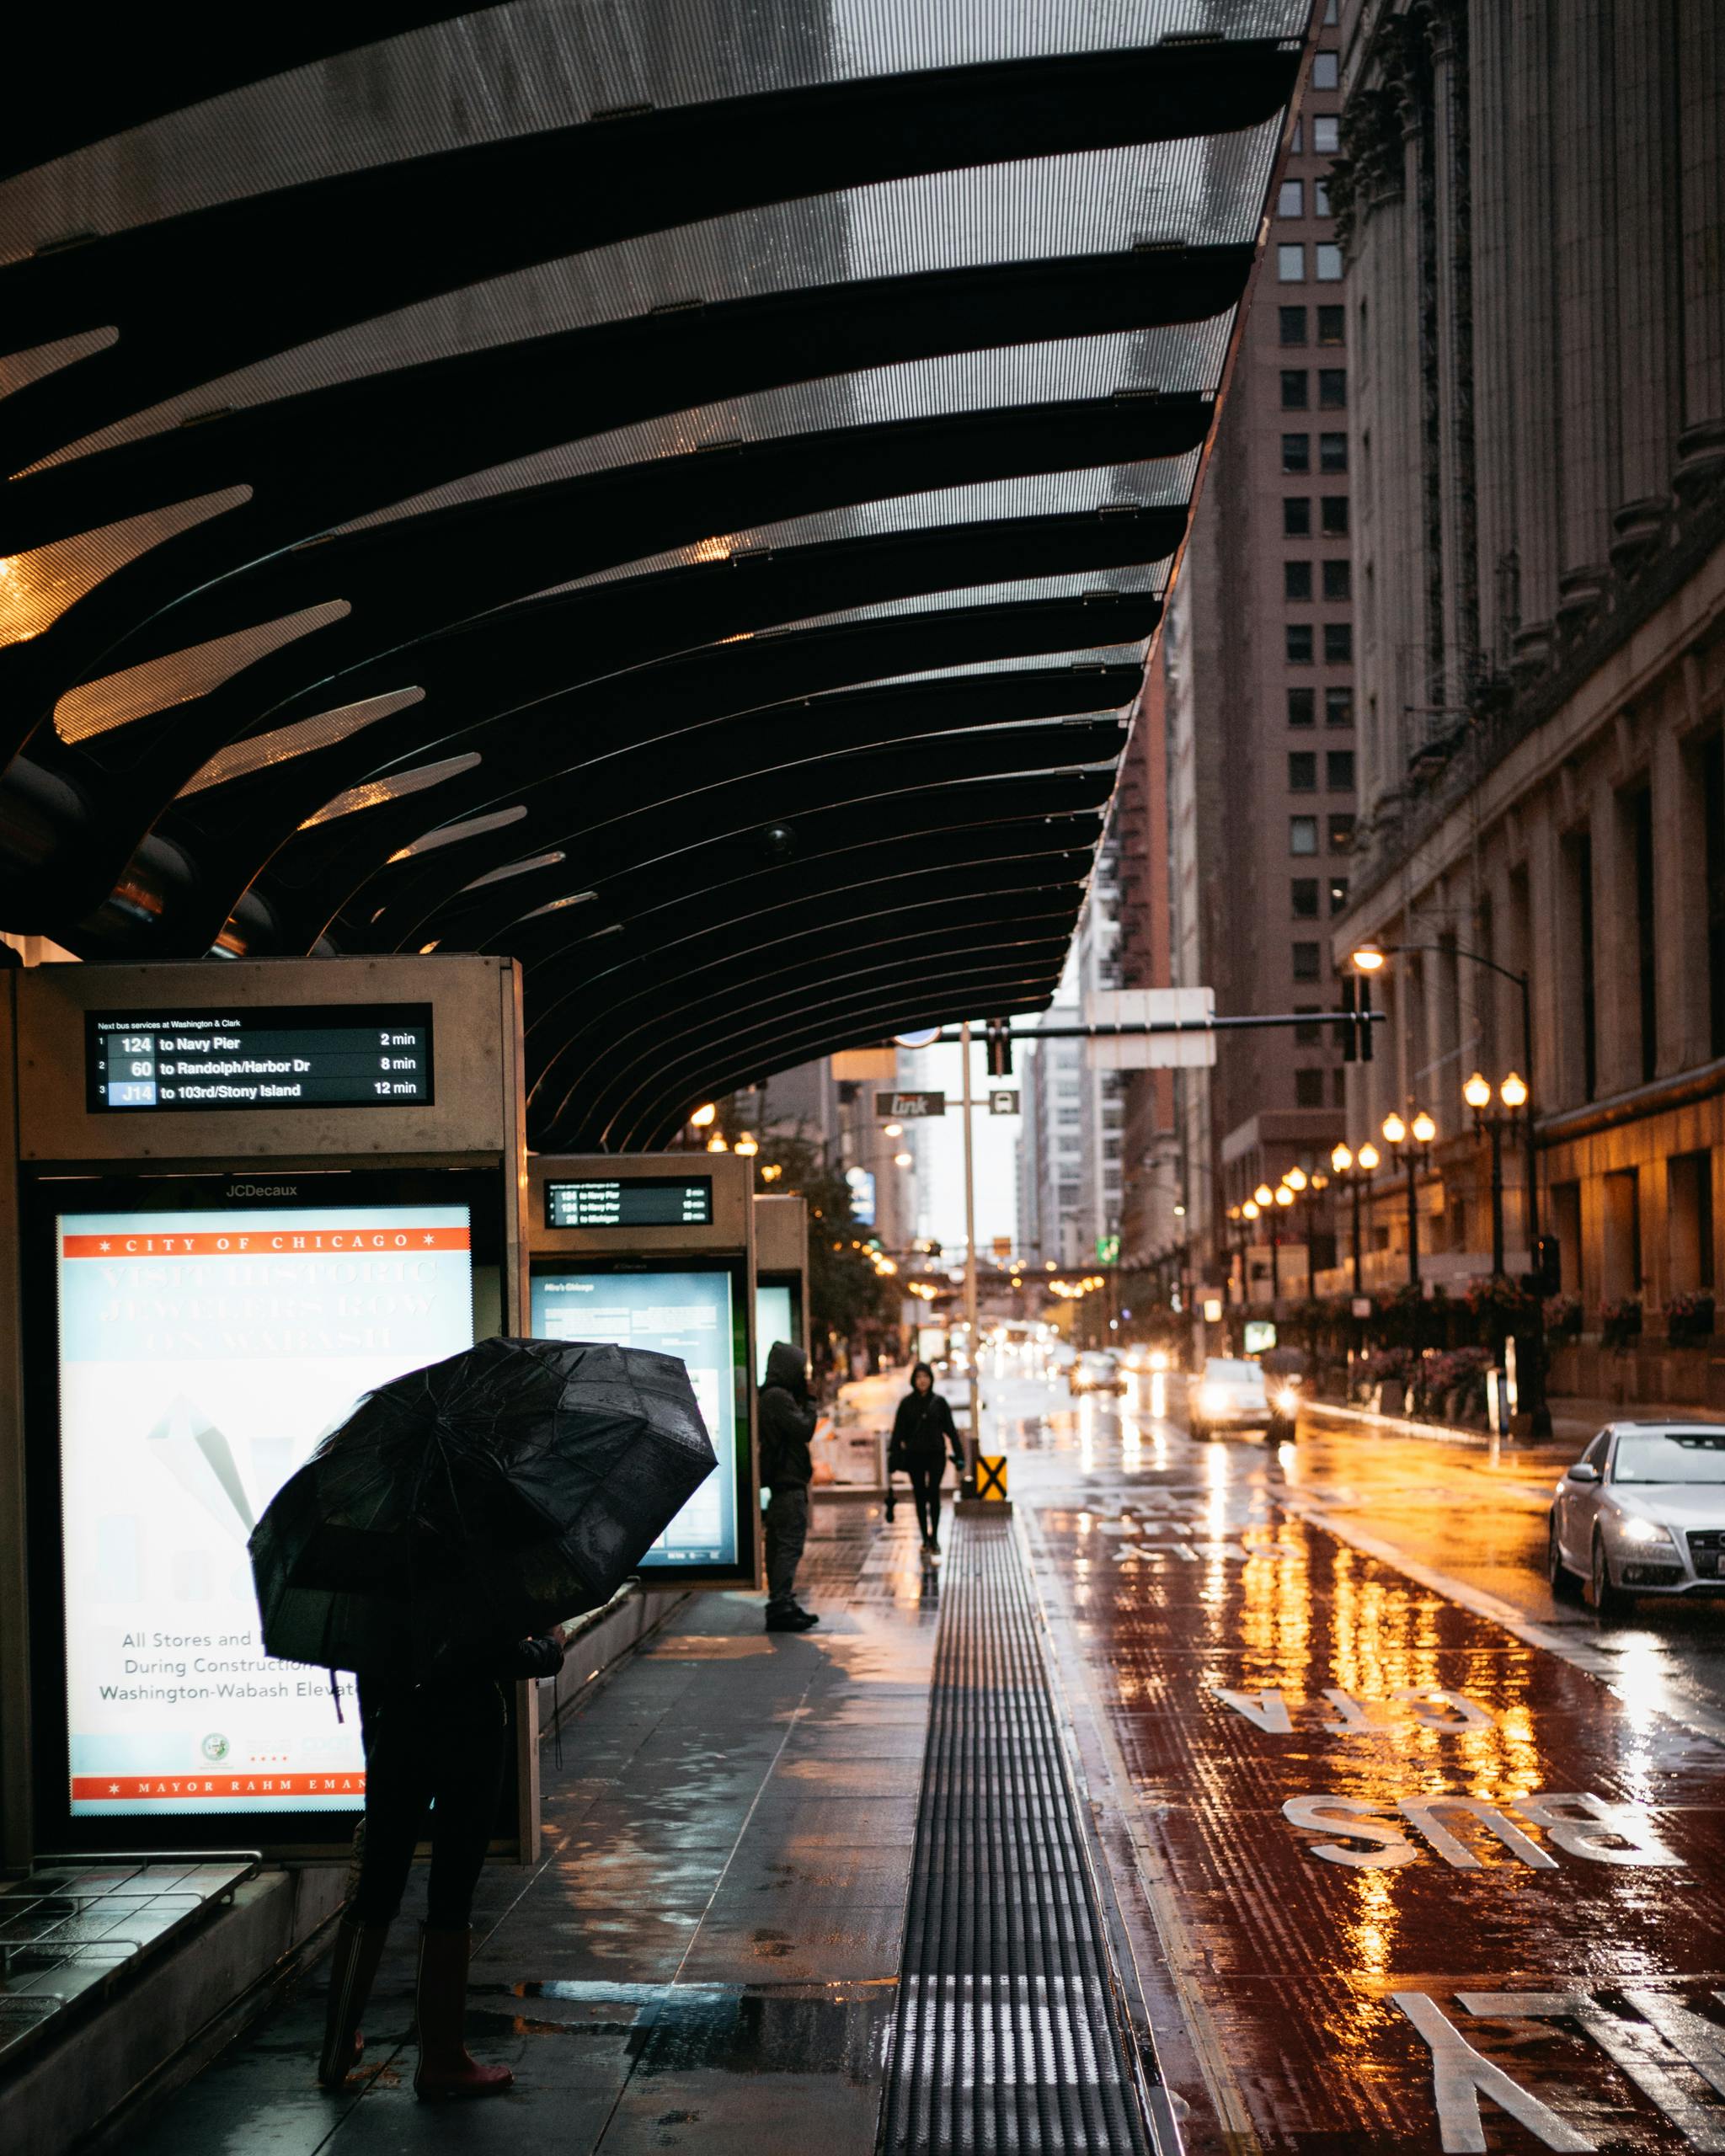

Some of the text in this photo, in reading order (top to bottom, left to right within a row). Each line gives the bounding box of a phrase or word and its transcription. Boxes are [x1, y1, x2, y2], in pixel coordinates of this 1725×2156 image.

[98, 1019, 241, 1031] Next bus services at Washington & Clark
[99, 1033, 416, 1053] 1 124 to Navy Pier 2 min
[99, 1057, 416, 1077] 2 60 to Randolph/Harbor Dr 8 min
[99, 1081, 417, 1101] 3 J14 to 103rd/Stony Island 12 min
[226, 1184, 297, 1198] JCDecaux
[126, 1234, 409, 1252] CITY OF CHICAGO
[100, 1259, 439, 1289] VISIT HISTORIC
[99, 1293, 437, 1322] JEWELERS ROW
[222, 1326, 392, 1351] WABASH
[122, 1632, 146, 1648] All
[153, 1632, 211, 1648] Stores
[218, 1630, 251, 1646] and
[125, 1657, 312, 1677] During Construction
[99, 1682, 289, 1704] Washington-Wabash
[1210, 1688, 1493, 1734] CTA
[138, 1782, 214, 1794] MAYOR
[231, 1779, 292, 1790] RAHM
[1281, 1792, 1687, 1870] BUS
